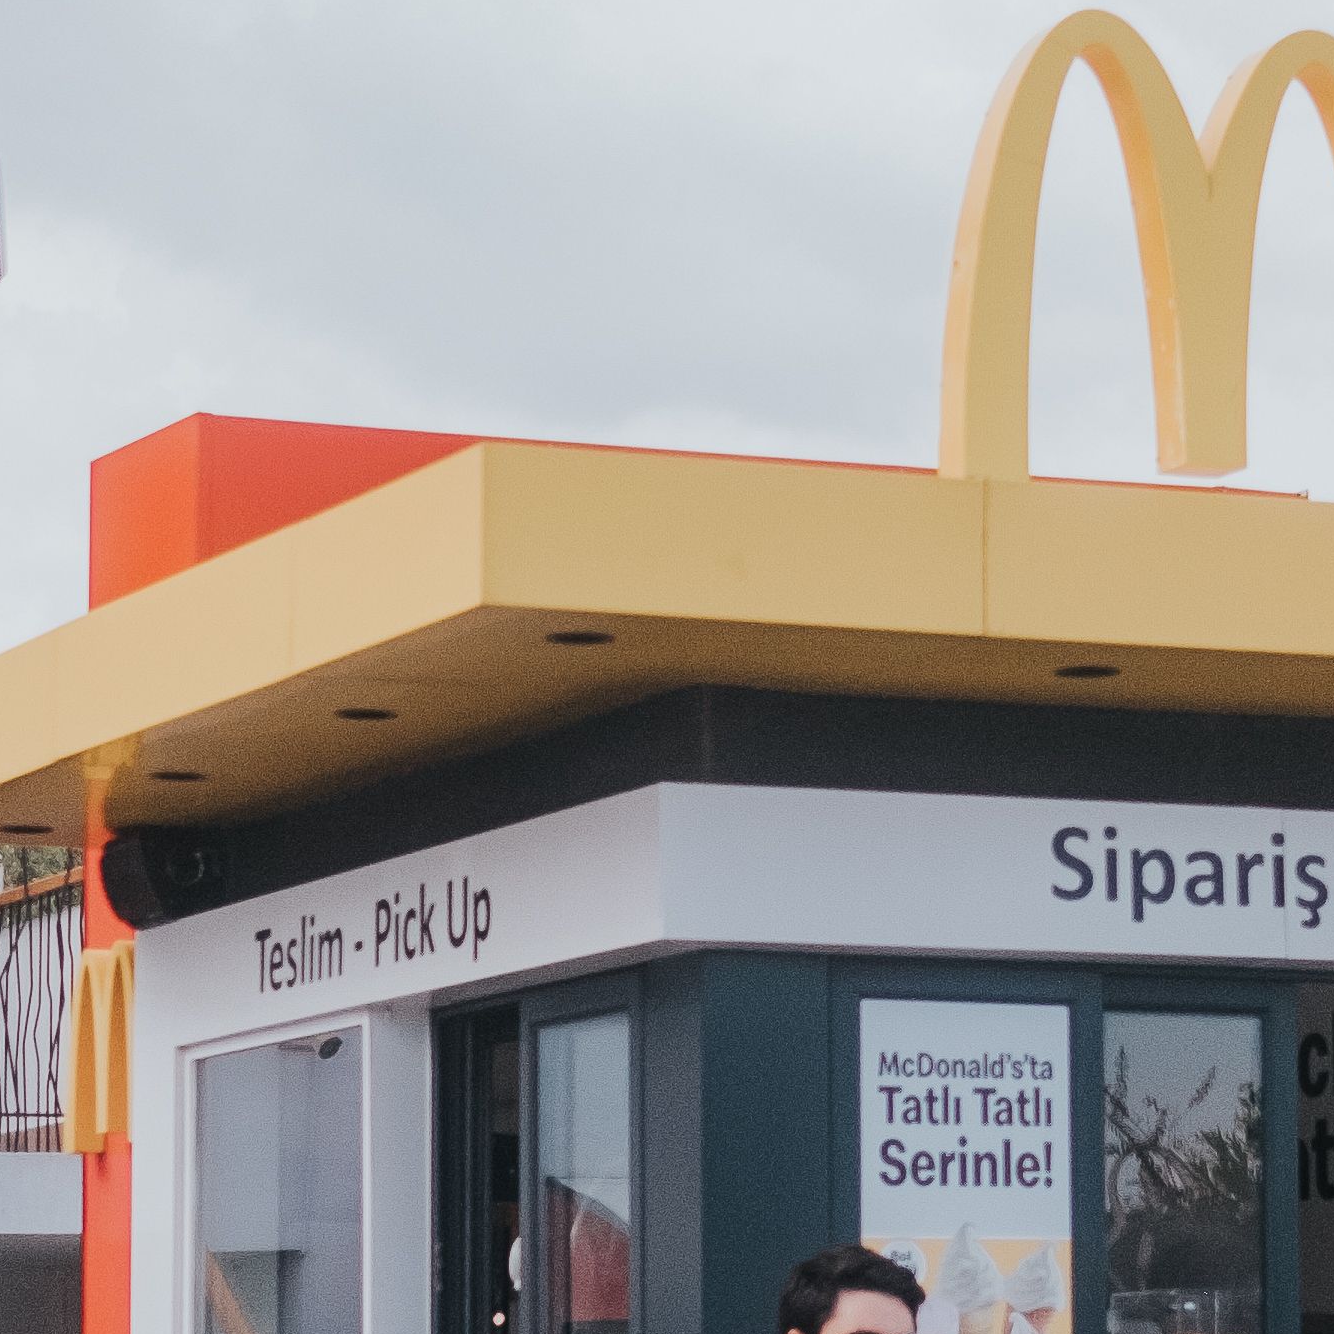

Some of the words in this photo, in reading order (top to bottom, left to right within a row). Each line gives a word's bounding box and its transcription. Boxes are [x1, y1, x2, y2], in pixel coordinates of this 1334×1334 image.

[1051, 826, 1329, 929] Sipariş
[255, 915, 343, 994] Teslim
[375, 882, 435, 967] Pick
[446, 875, 492, 963] Up
[878, 1084, 962, 1126] Tatlı
[972, 1086, 1053, 1128] Tatlı
[878, 1135, 1053, 1189] Serinle!
